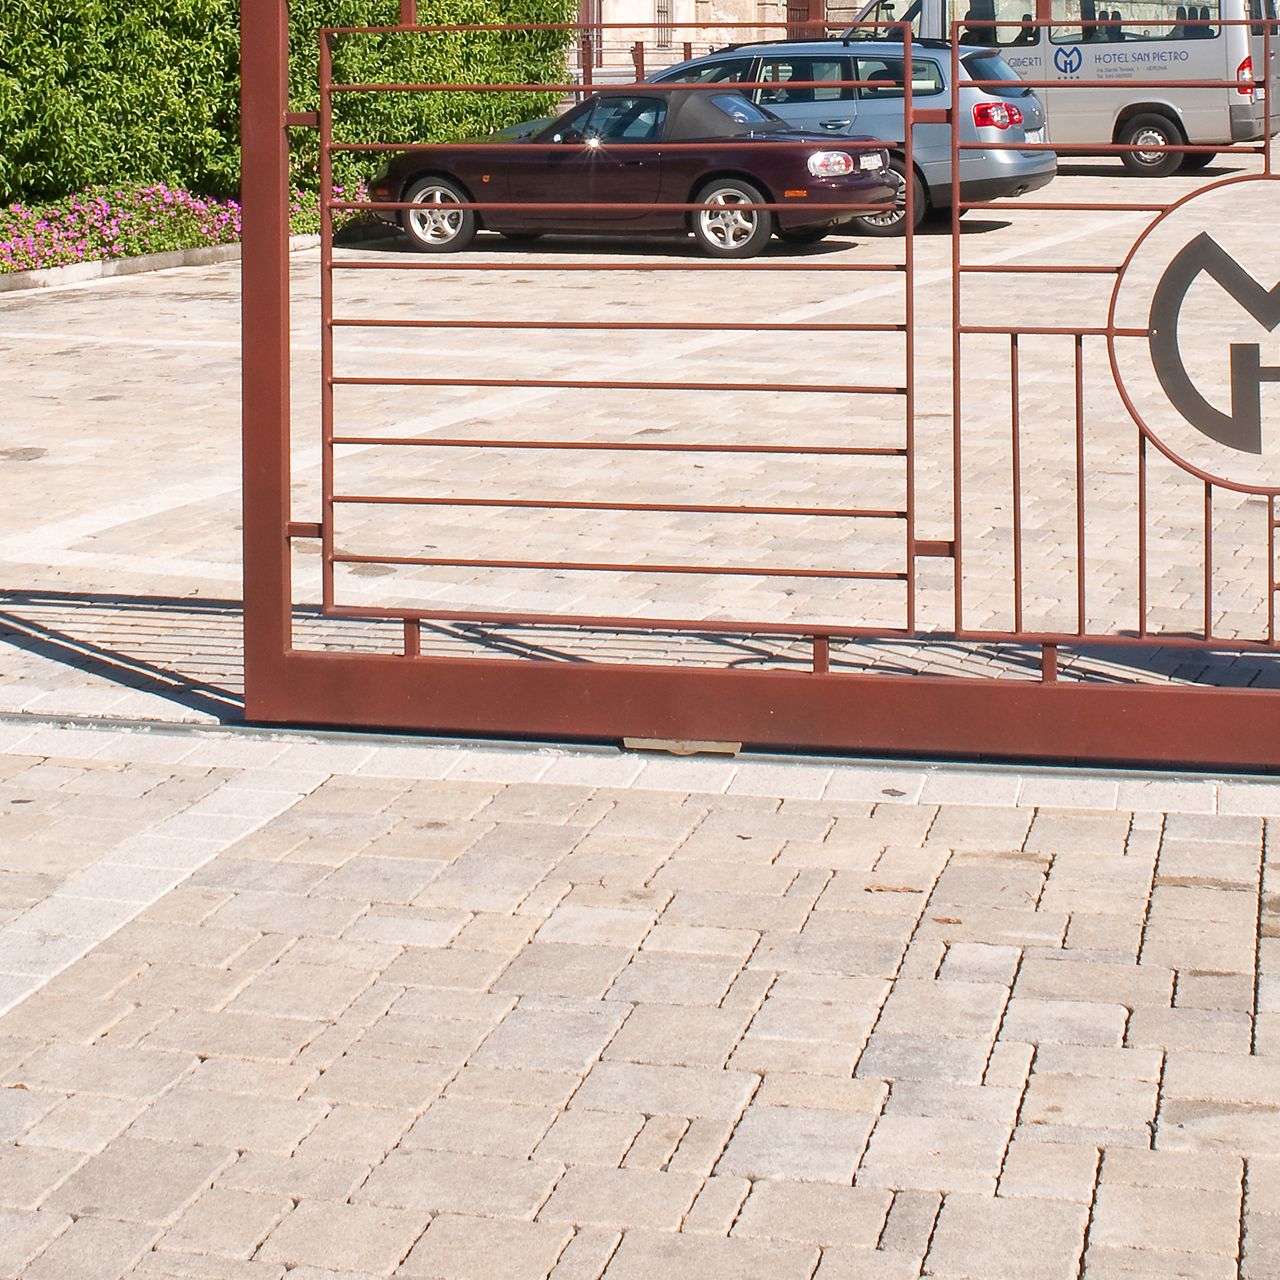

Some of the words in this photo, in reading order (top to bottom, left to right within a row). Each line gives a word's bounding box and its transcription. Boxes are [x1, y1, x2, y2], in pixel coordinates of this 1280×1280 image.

[1094, 52, 1129, 64] HOTEL
[1132, 51, 1150, 62] SAN
[1152, 50, 1189, 62] PIETRO
